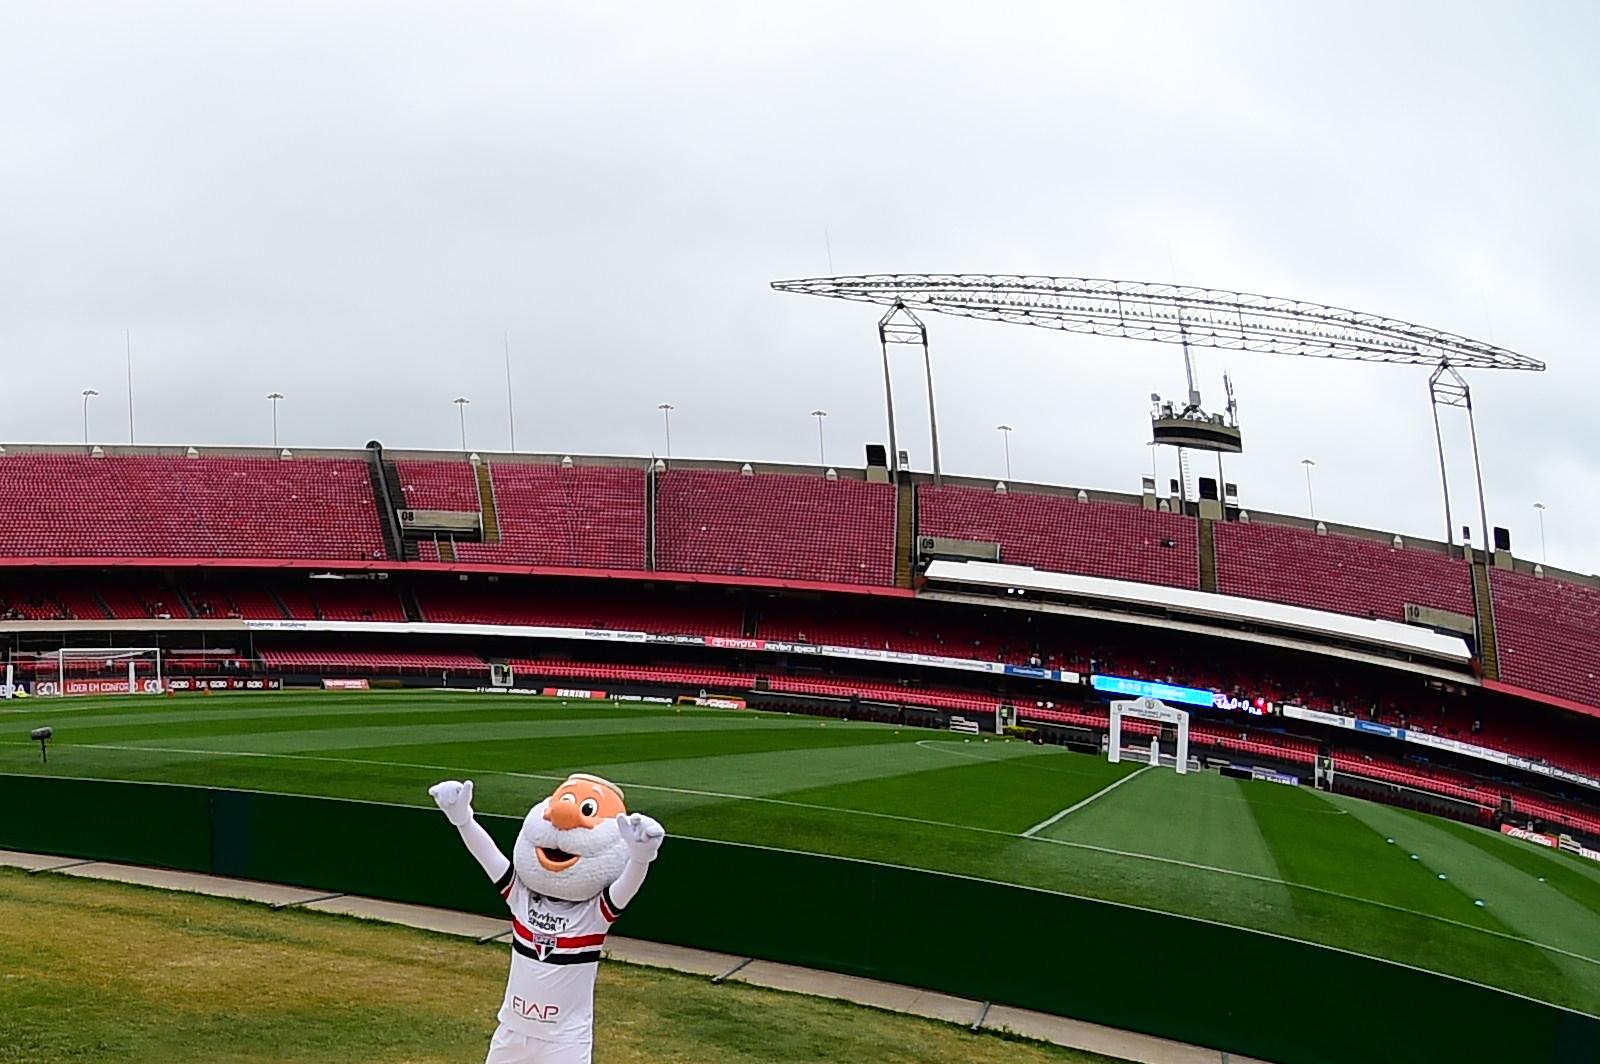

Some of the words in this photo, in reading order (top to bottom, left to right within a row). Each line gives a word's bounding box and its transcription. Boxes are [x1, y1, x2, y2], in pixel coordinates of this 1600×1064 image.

[401, 511, 414, 521] 08
[921, 538, 934, 549] 09
[1408, 605, 1420, 618] 10
[725, 639, 758, 649] TOYOTA
[36, 681, 61, 695] GOL
[89, 682, 100, 692] EM
[512, 995, 559, 1020] FIAP
